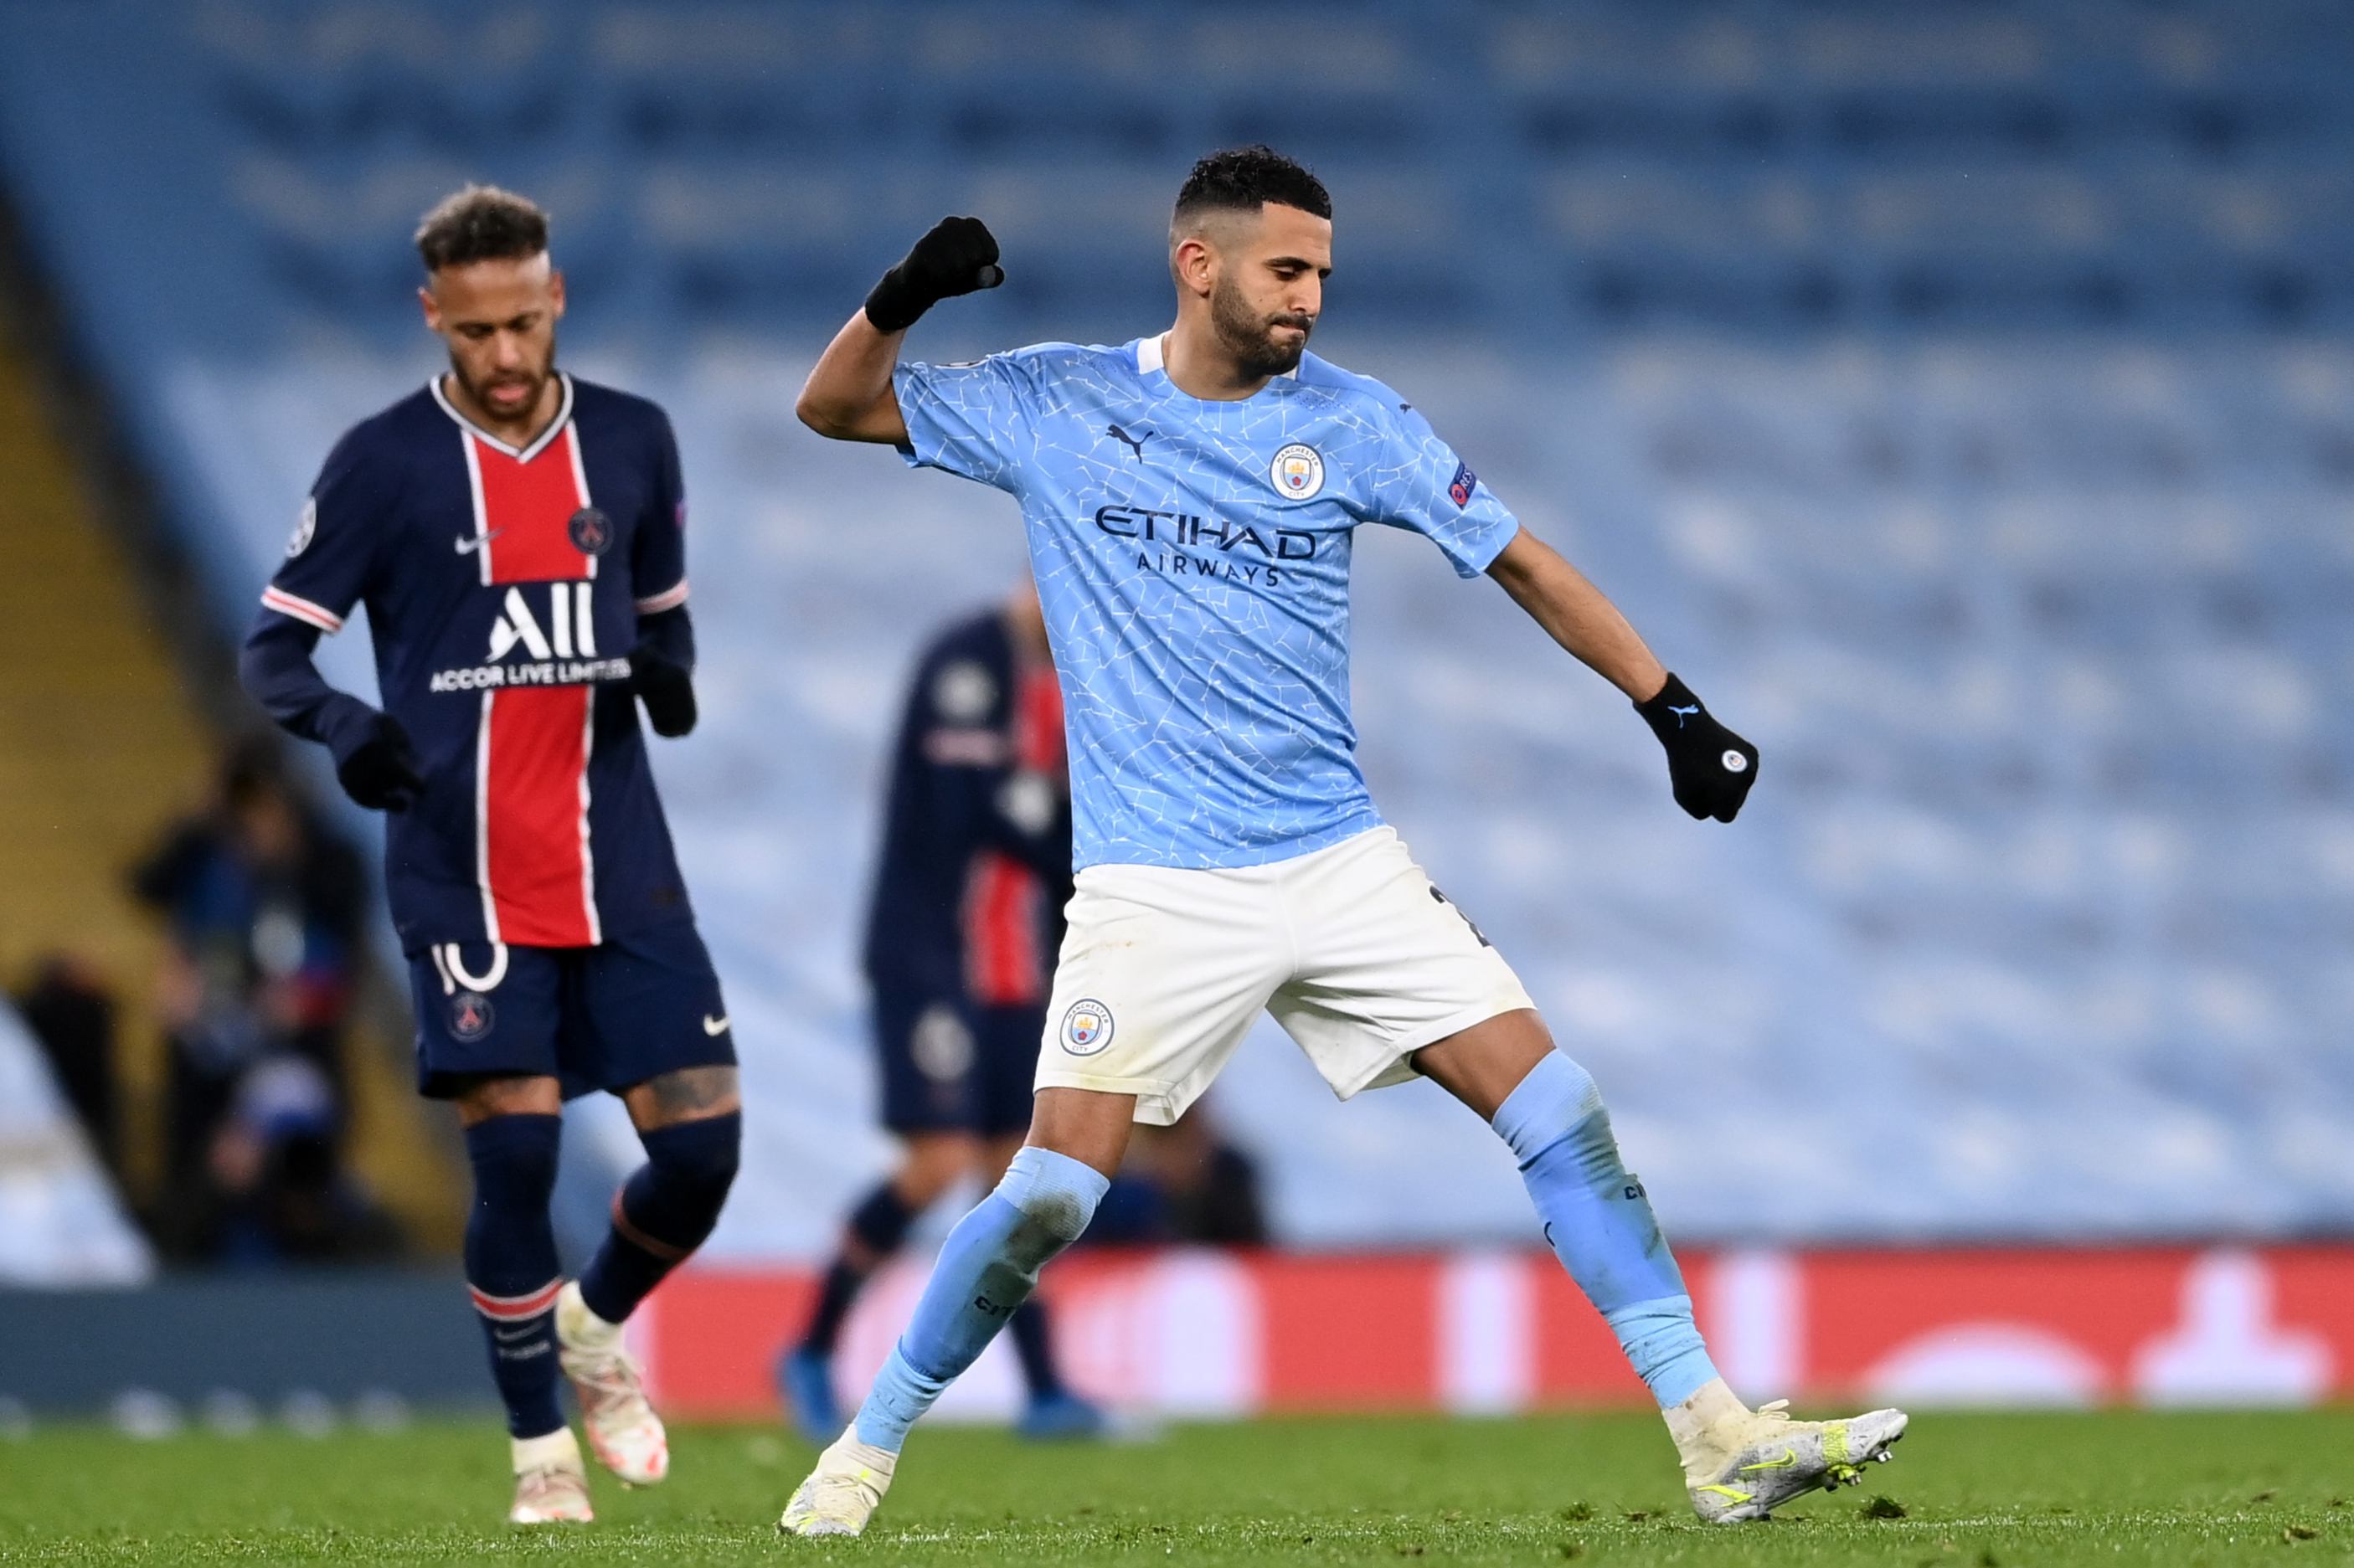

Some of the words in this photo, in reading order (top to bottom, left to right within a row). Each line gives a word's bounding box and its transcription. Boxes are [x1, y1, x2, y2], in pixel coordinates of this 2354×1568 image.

[1277, 448, 1318, 465] MANCHESTER
[1095, 505, 1316, 559] ETIHAD
[1137, 553, 1278, 586] AIRWAYS
[430, 666, 504, 691] ACCOR
[508, 664, 554, 684] LIVE
[1069, 1004, 1109, 1023] MANCHESTER
